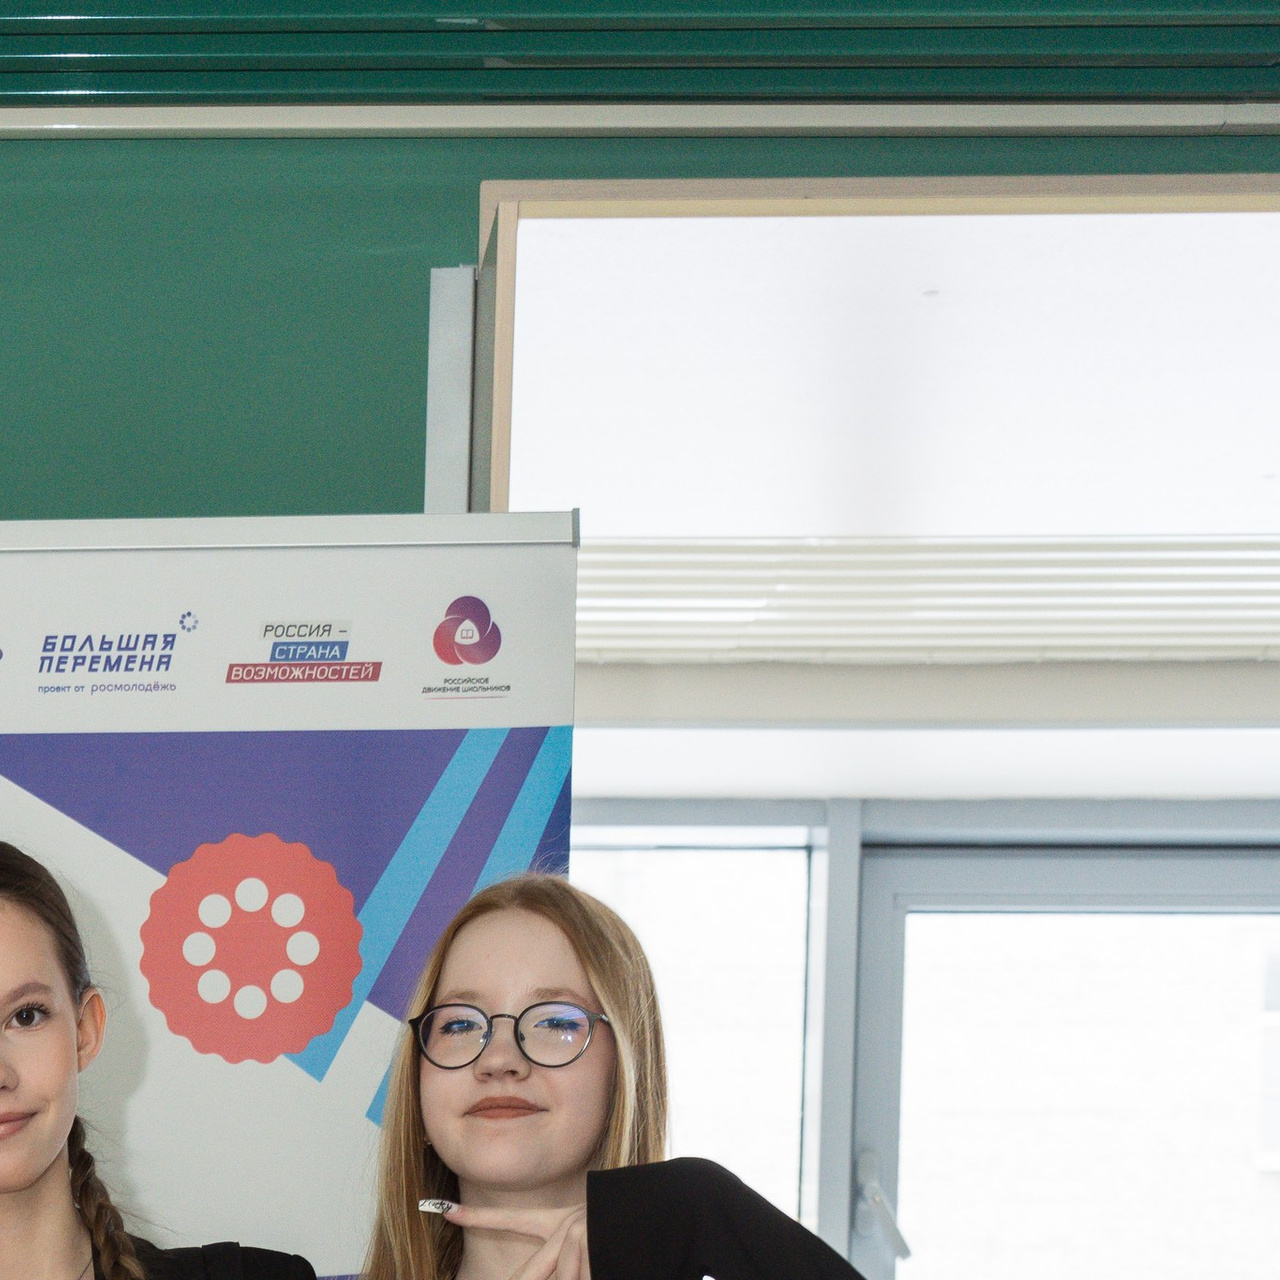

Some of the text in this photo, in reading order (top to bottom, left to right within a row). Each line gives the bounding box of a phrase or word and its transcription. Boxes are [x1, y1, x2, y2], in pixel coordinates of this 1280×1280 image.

[263, 624, 332, 638] РОССИЯ
[42, 633, 177, 652] БОЛЬШАЯ
[275, 645, 341, 659] СТРАНА
[38, 654, 172, 673] ПЕРЕМЕНА
[231, 663, 374, 680] ВОЗМОЖНОСТЕЙ
[38, 681, 177, 695] проект от росмолодёжь
[444, 677, 489, 685] РОССИЙСКОЕ
[422, 685, 511, 694] ДВИЖЕНИЕ ШКОЛЬНИКОВ
